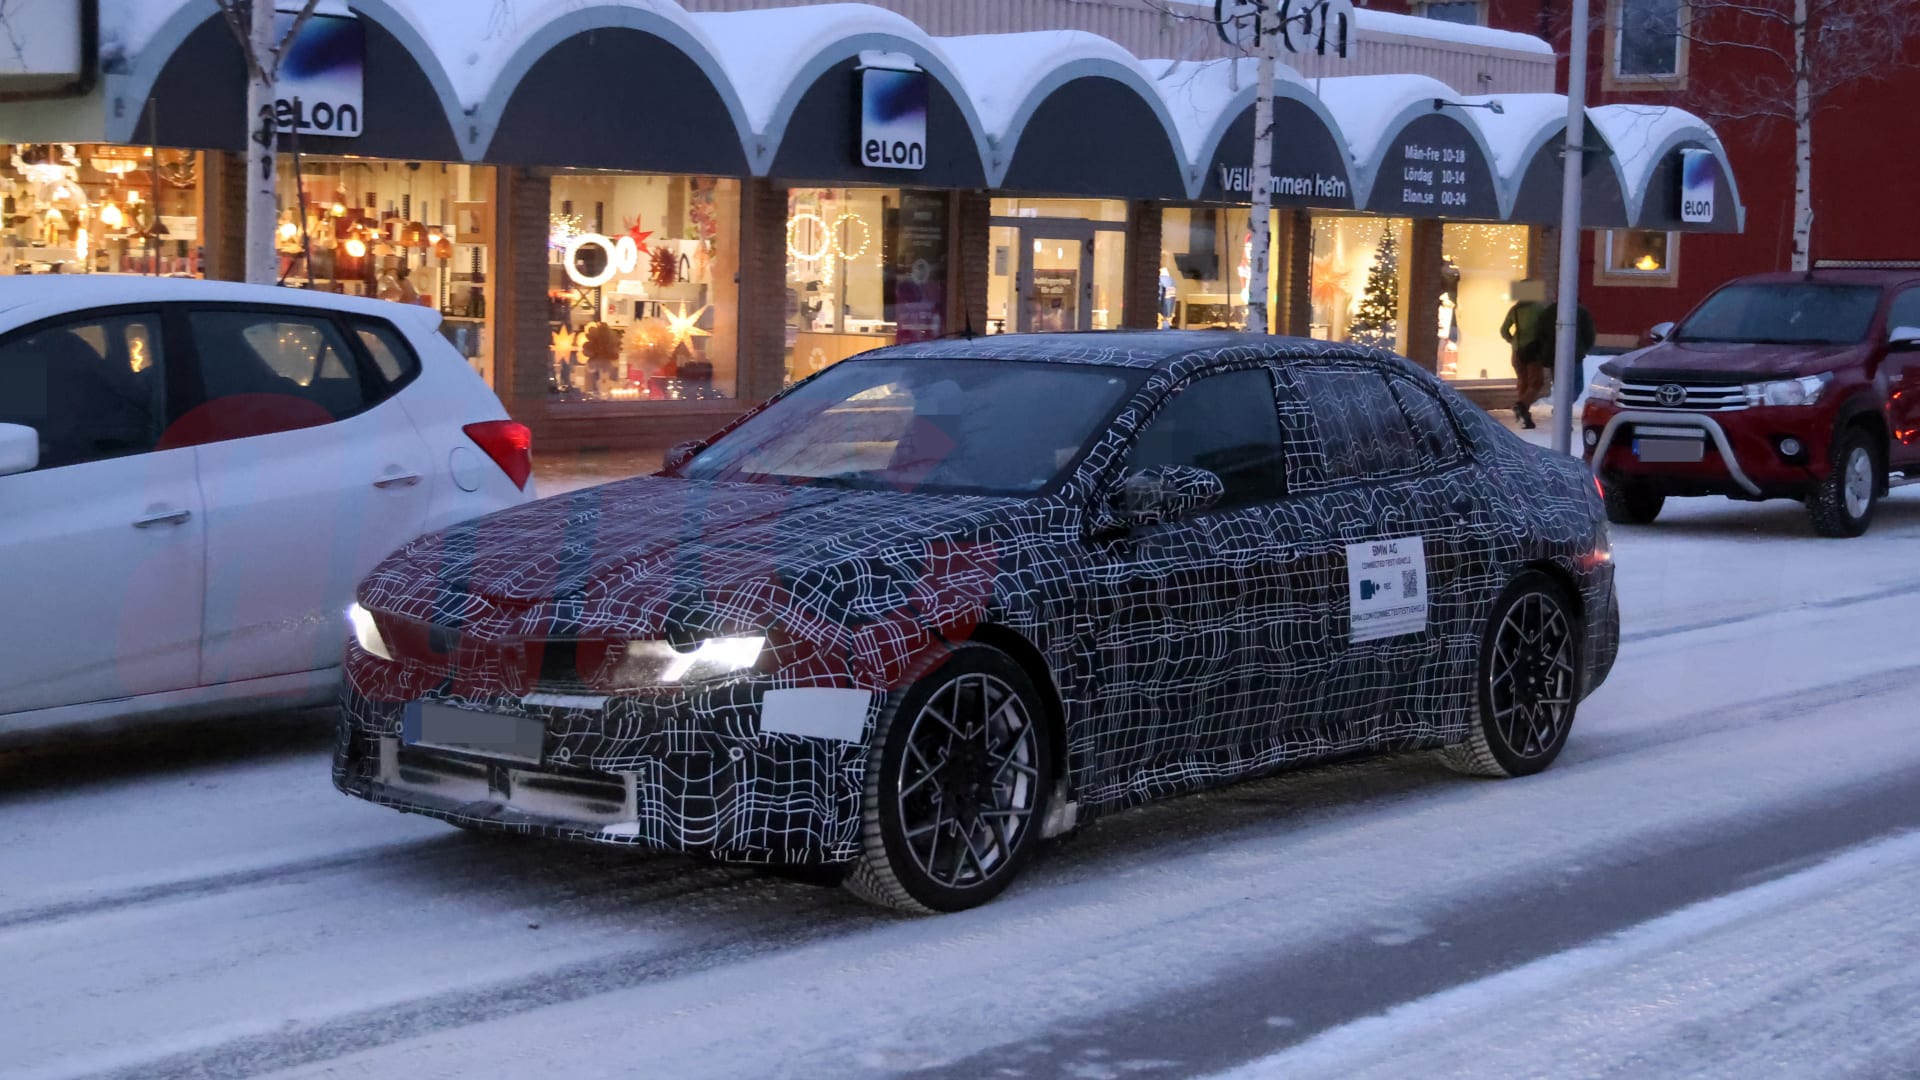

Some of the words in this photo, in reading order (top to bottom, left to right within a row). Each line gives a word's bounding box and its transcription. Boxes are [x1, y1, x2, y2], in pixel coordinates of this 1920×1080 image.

[1442, 148, 1466, 164] 10-18
[1314, 173, 1346, 198] hem
[1404, 167, 1434, 186] Lördag
[1442, 169, 1465, 185] 10-14
[1403, 188, 1434, 204] Elon.se
[1441, 191, 1467, 206] 00-24
[1371, 544, 1388, 556] BMW
[1389, 543, 1398, 555] AG
